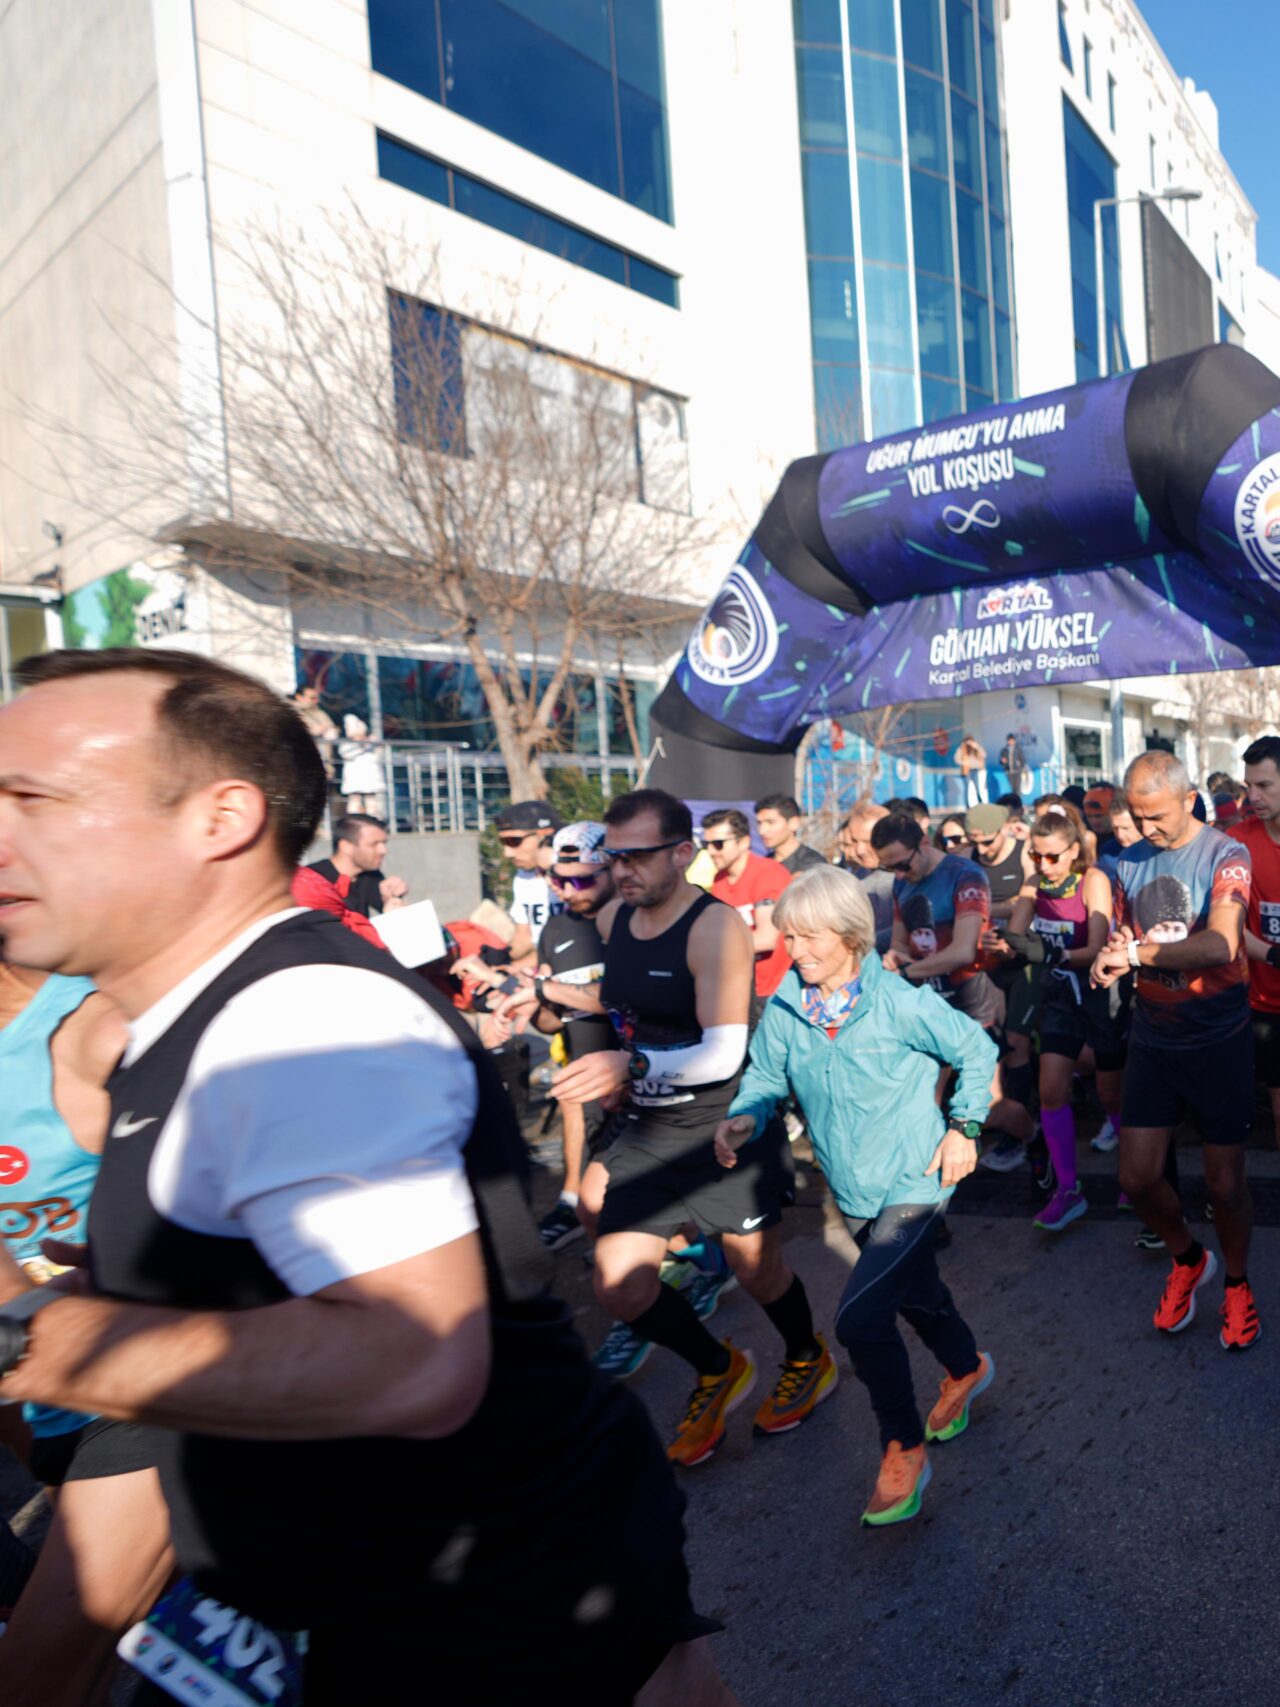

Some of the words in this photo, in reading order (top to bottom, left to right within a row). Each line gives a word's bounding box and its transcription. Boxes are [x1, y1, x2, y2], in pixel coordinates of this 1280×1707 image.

[866, 440, 912, 474] UĞUR
[911, 416, 1009, 463] MUMCU'YU
[1008, 403, 1066, 442] ANMA
[907, 463, 943, 498] YOL
[943, 448, 1015, 492] KOŞUSU
[930, 621, 1011, 666] GÖKHAN
[1015, 612, 1099, 652] YÜKSEL
[929, 664, 970, 686] Kartal
[973, 655, 1034, 680] Belediye
[1036, 651, 1100, 671] Başkanı
